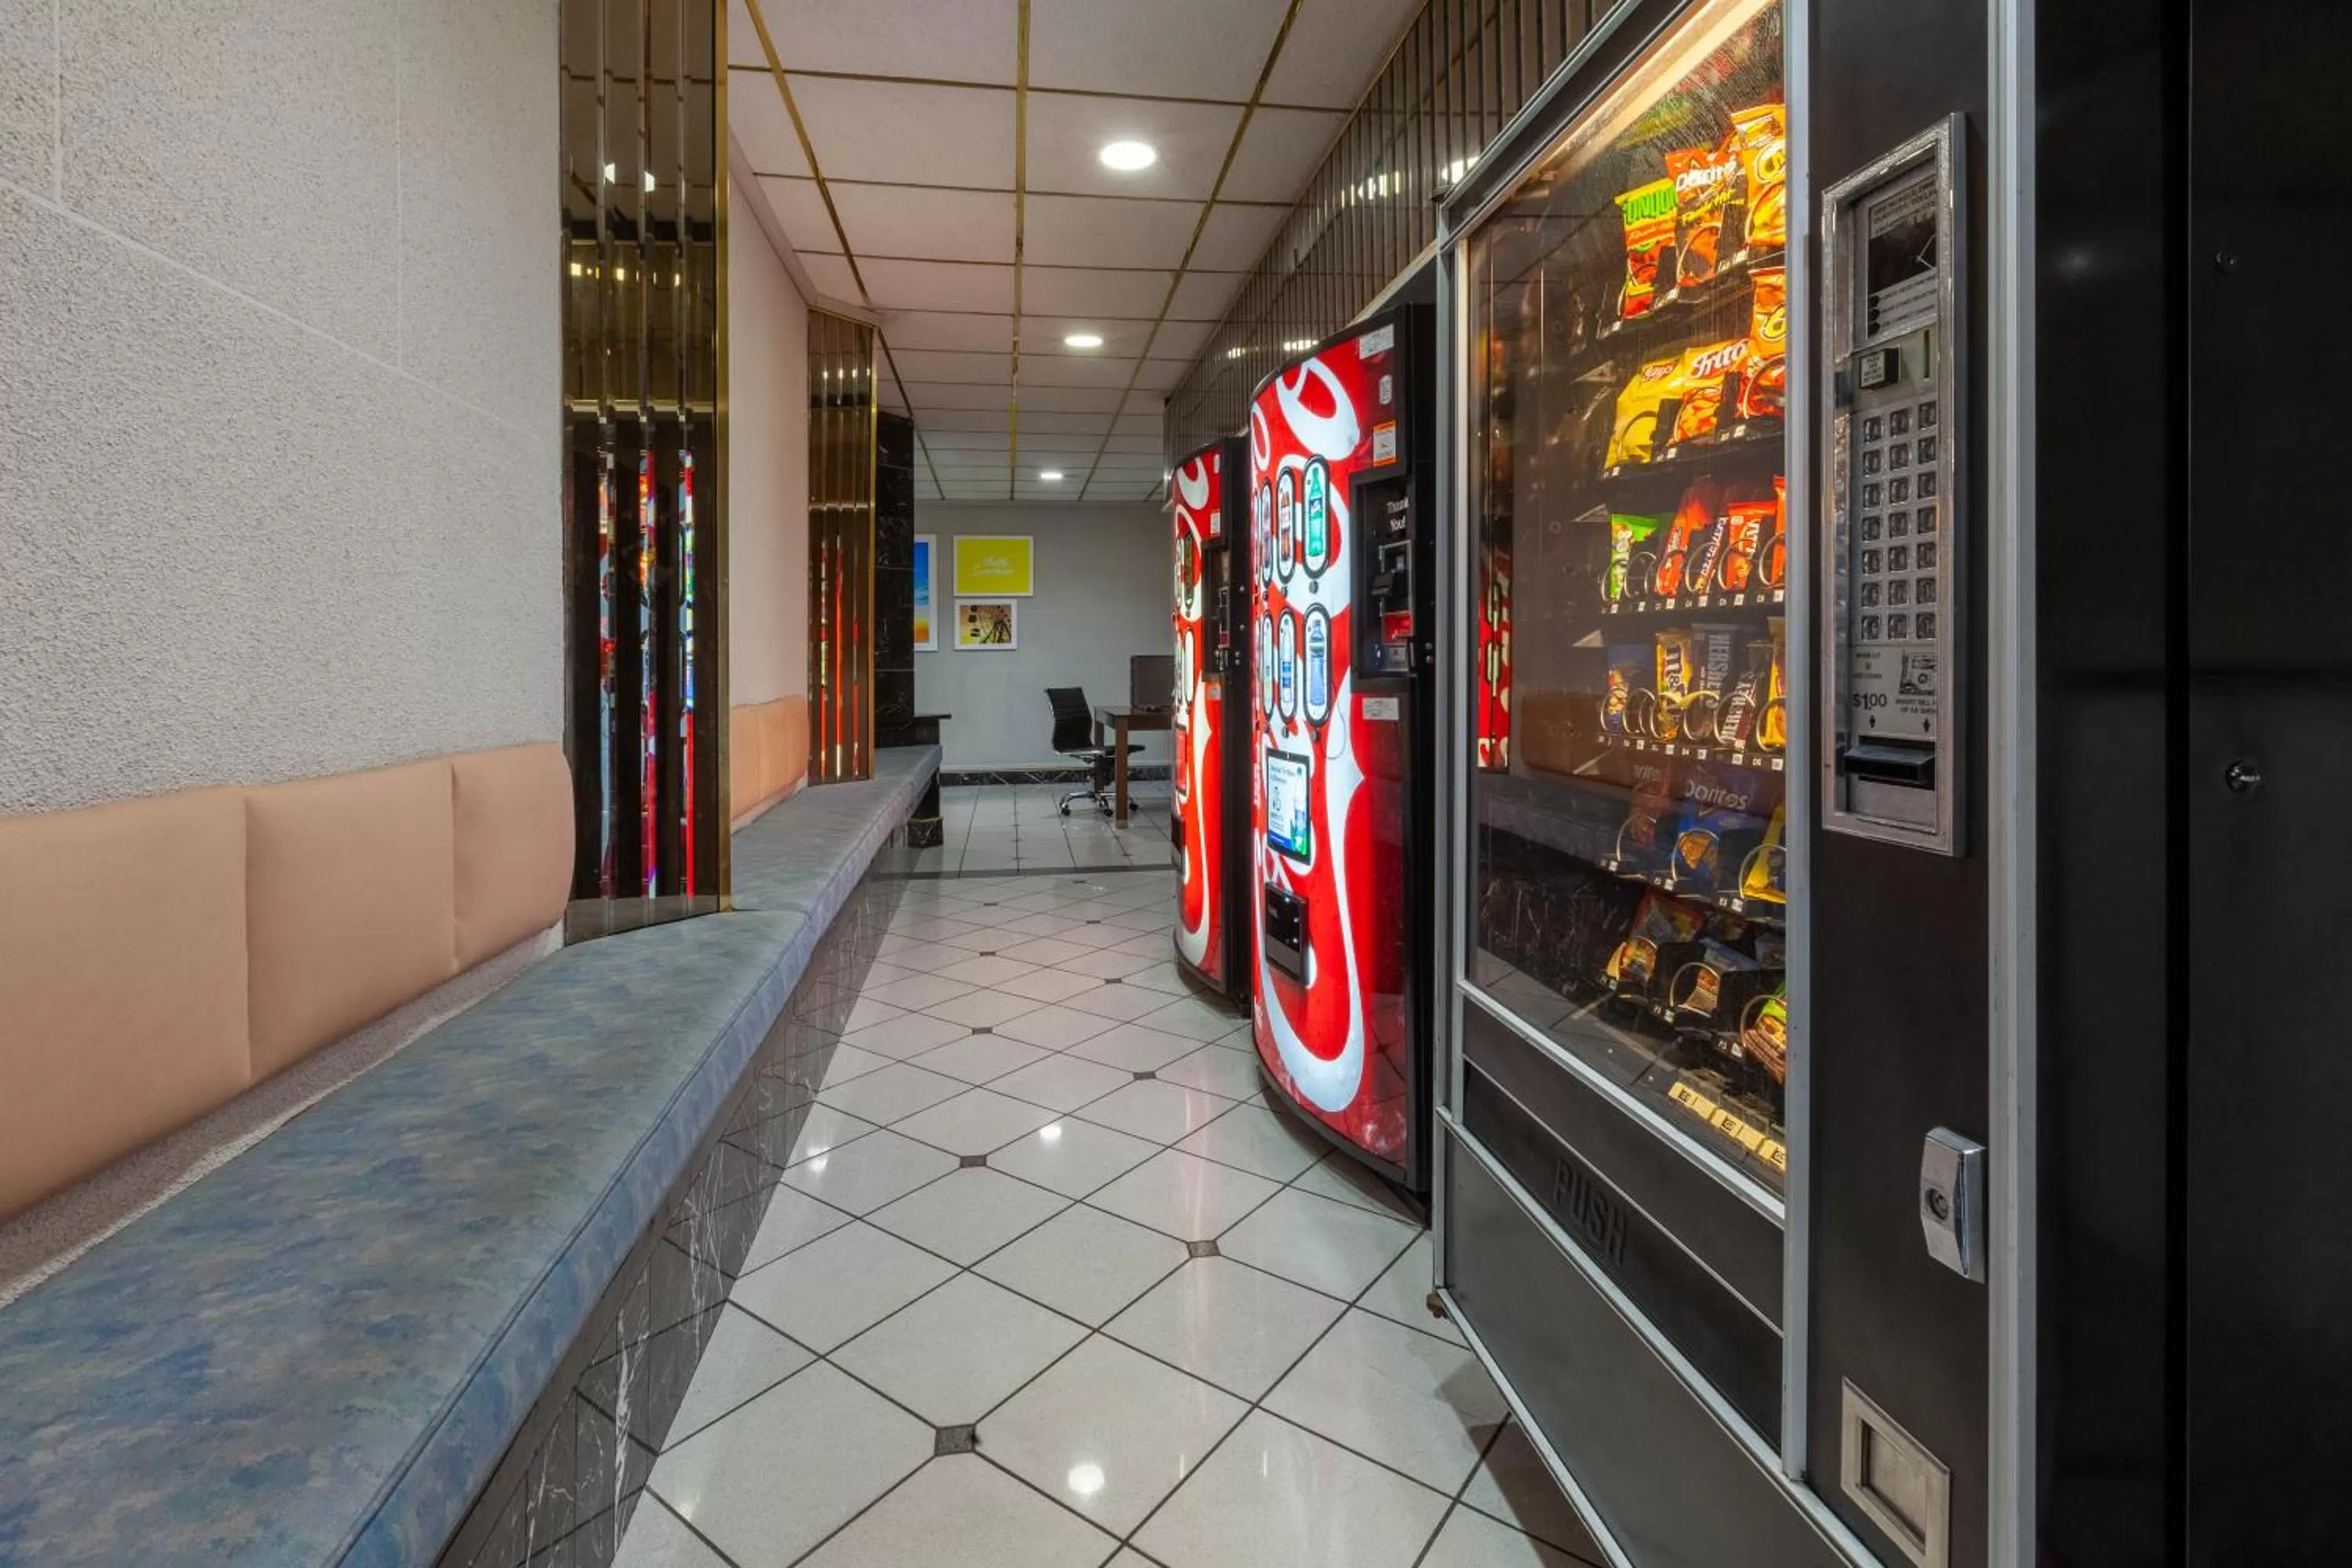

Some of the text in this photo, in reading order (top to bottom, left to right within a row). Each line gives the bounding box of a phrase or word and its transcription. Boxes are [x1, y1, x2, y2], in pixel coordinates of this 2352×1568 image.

[1691, 340, 1749, 379] Frito
[1706, 633, 1731, 709] HERSHES
[1853, 692, 1887, 710] $1.00
[1684, 779, 1748, 810] Doritos
[1555, 1156, 1628, 1266] PUSH
